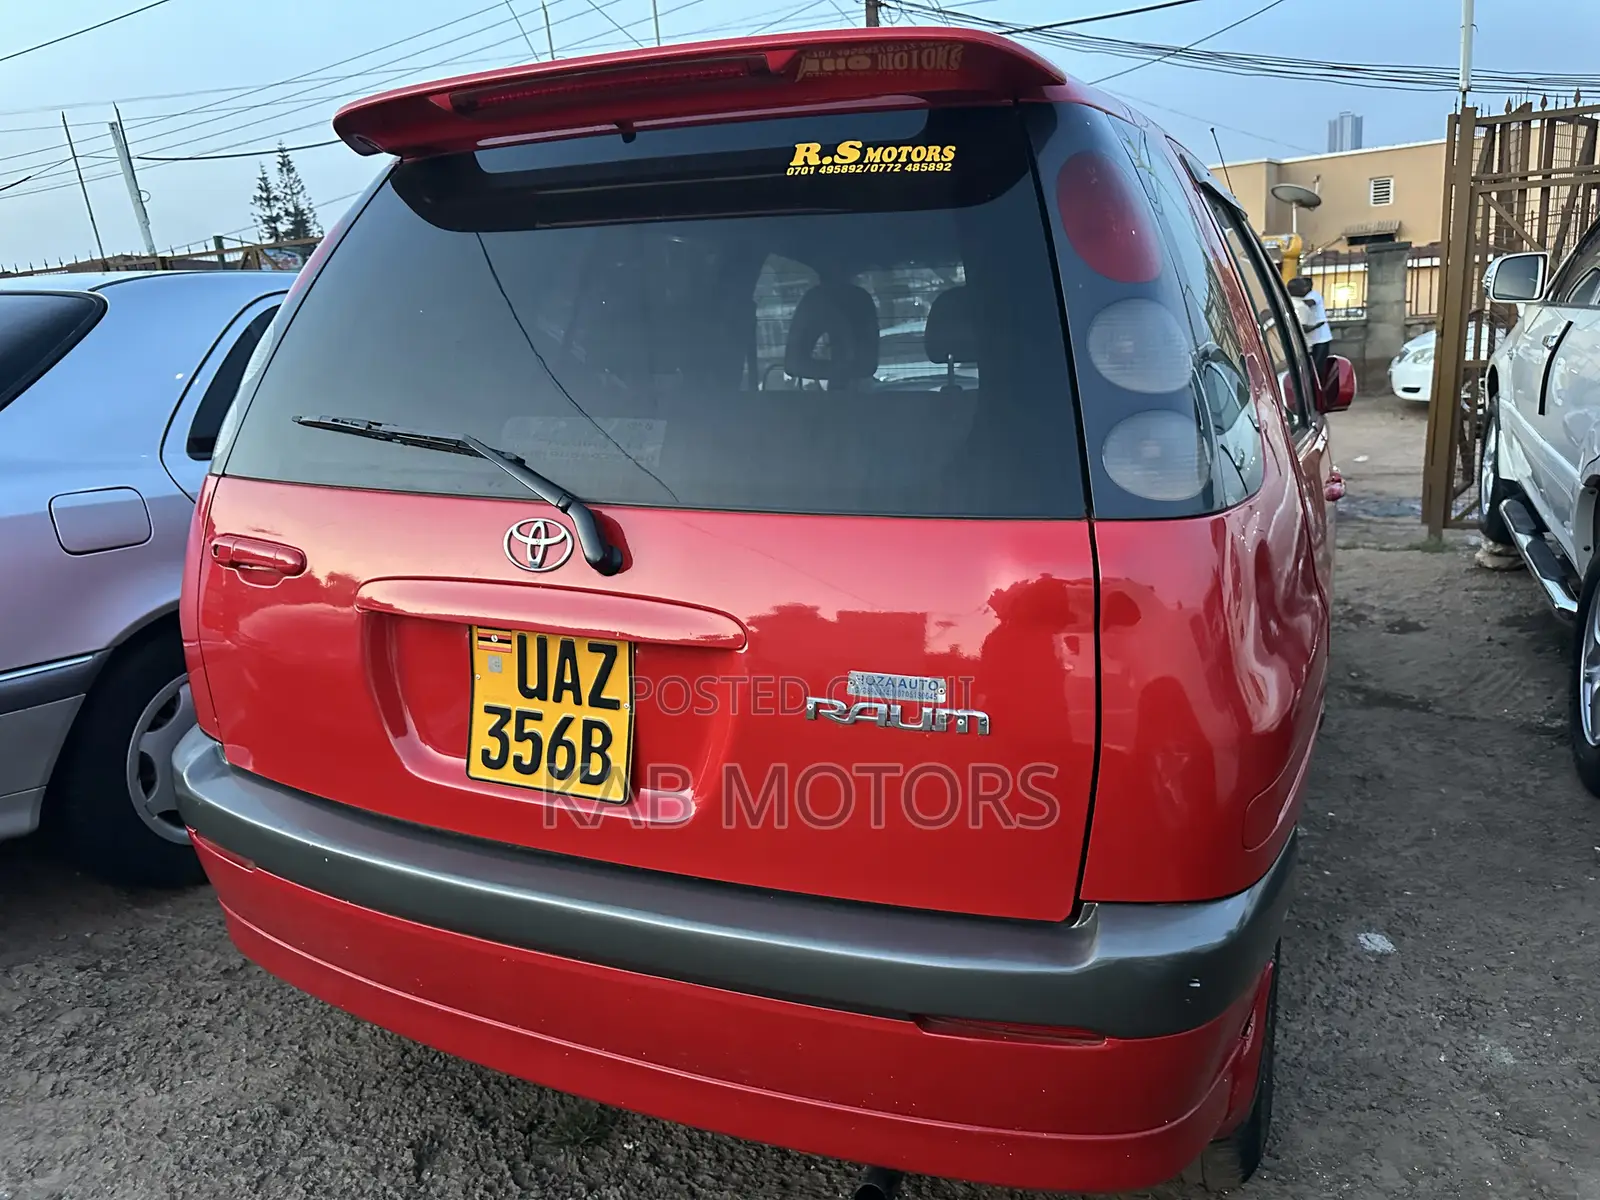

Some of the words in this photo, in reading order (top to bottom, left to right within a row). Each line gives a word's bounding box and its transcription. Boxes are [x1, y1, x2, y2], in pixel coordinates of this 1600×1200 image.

[789, 140, 863, 166] R.S
[863, 145, 956, 164] MOTORS
[786, 165, 815, 176] 0701
[819, 163, 901, 175] 495892/0772
[904, 162, 952, 172] 485892
[516, 632, 621, 710] UAZ
[898, 678, 939, 691] AUTO
[480, 703, 613, 786] 356B
